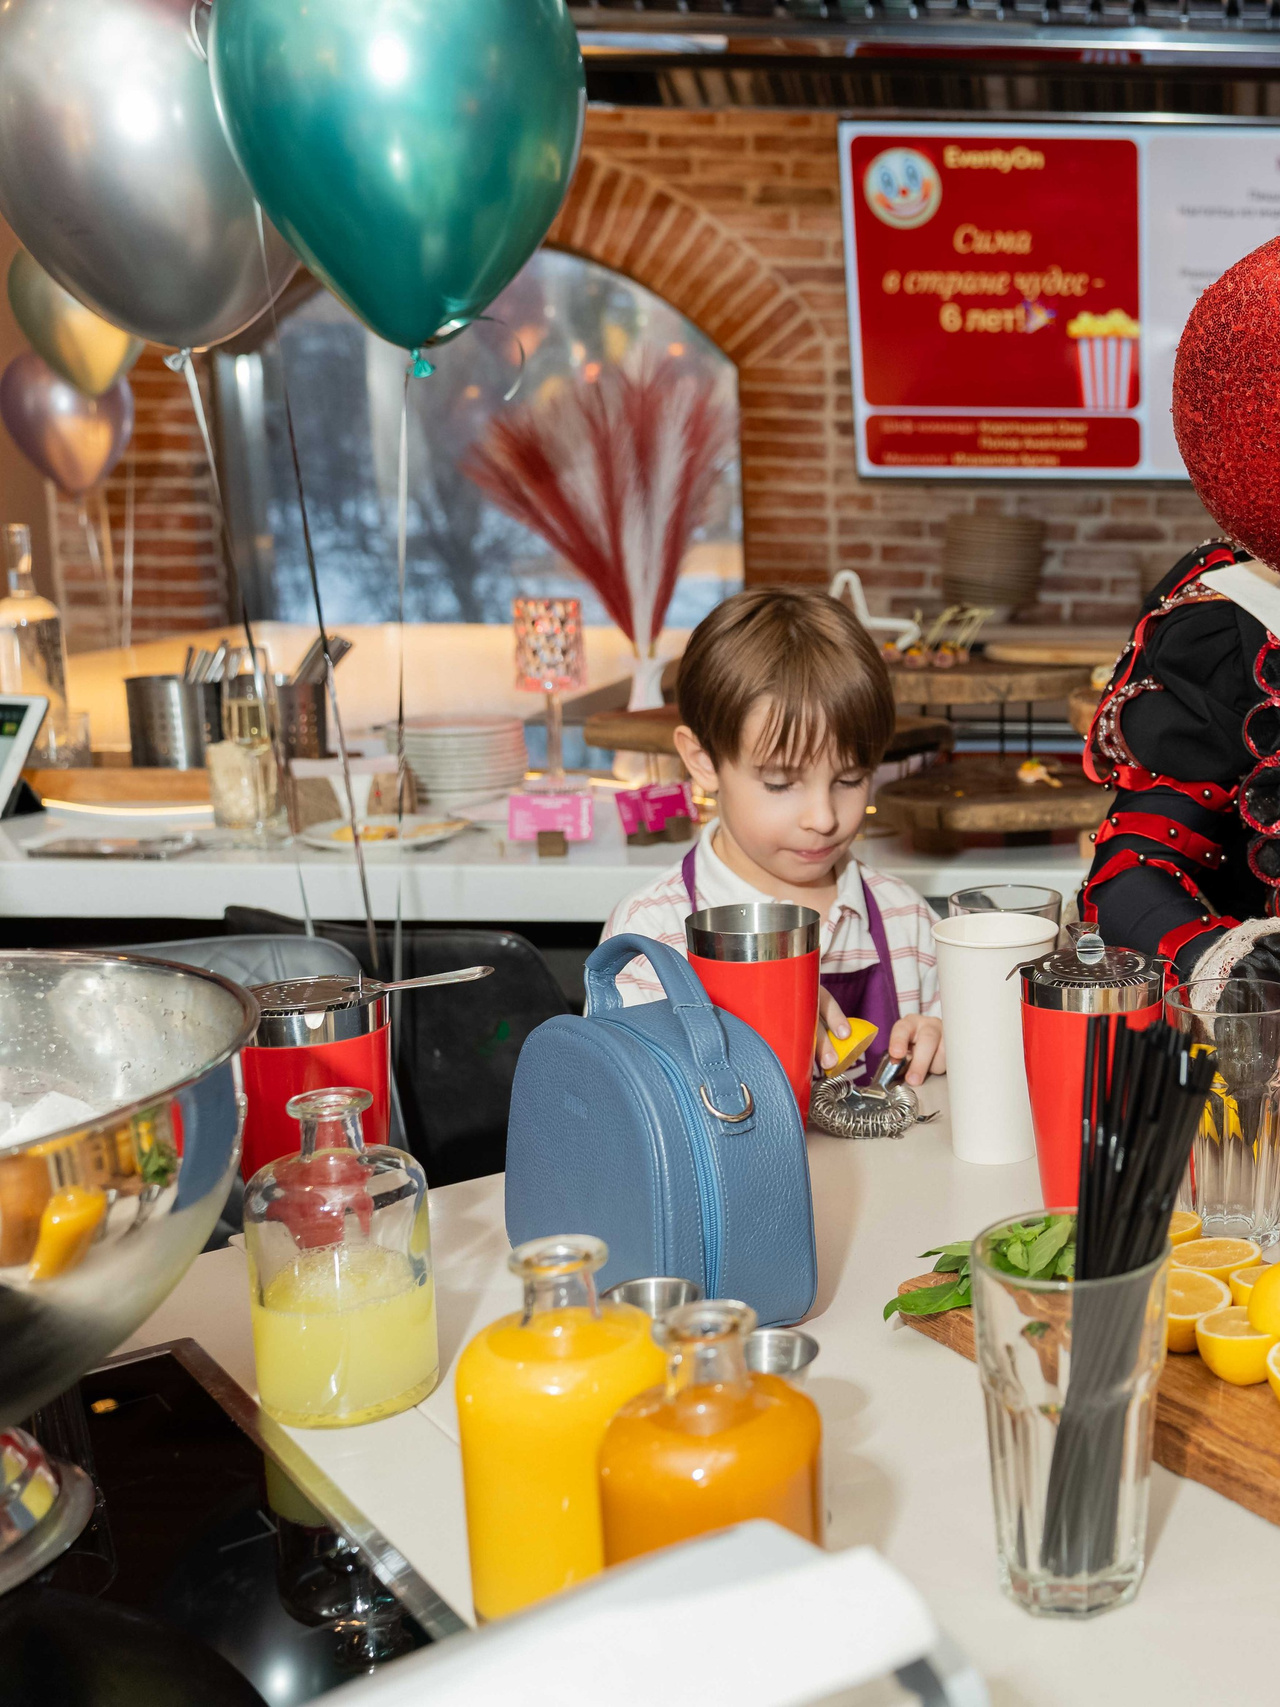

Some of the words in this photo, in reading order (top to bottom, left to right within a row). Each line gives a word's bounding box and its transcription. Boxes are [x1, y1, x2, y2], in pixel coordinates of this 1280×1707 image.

[954, 224, 1032, 255] Сима
[904, 271, 1010, 300] стране
[1014, 265, 1089, 299] чудес
[940, 302, 962, 333] 6
